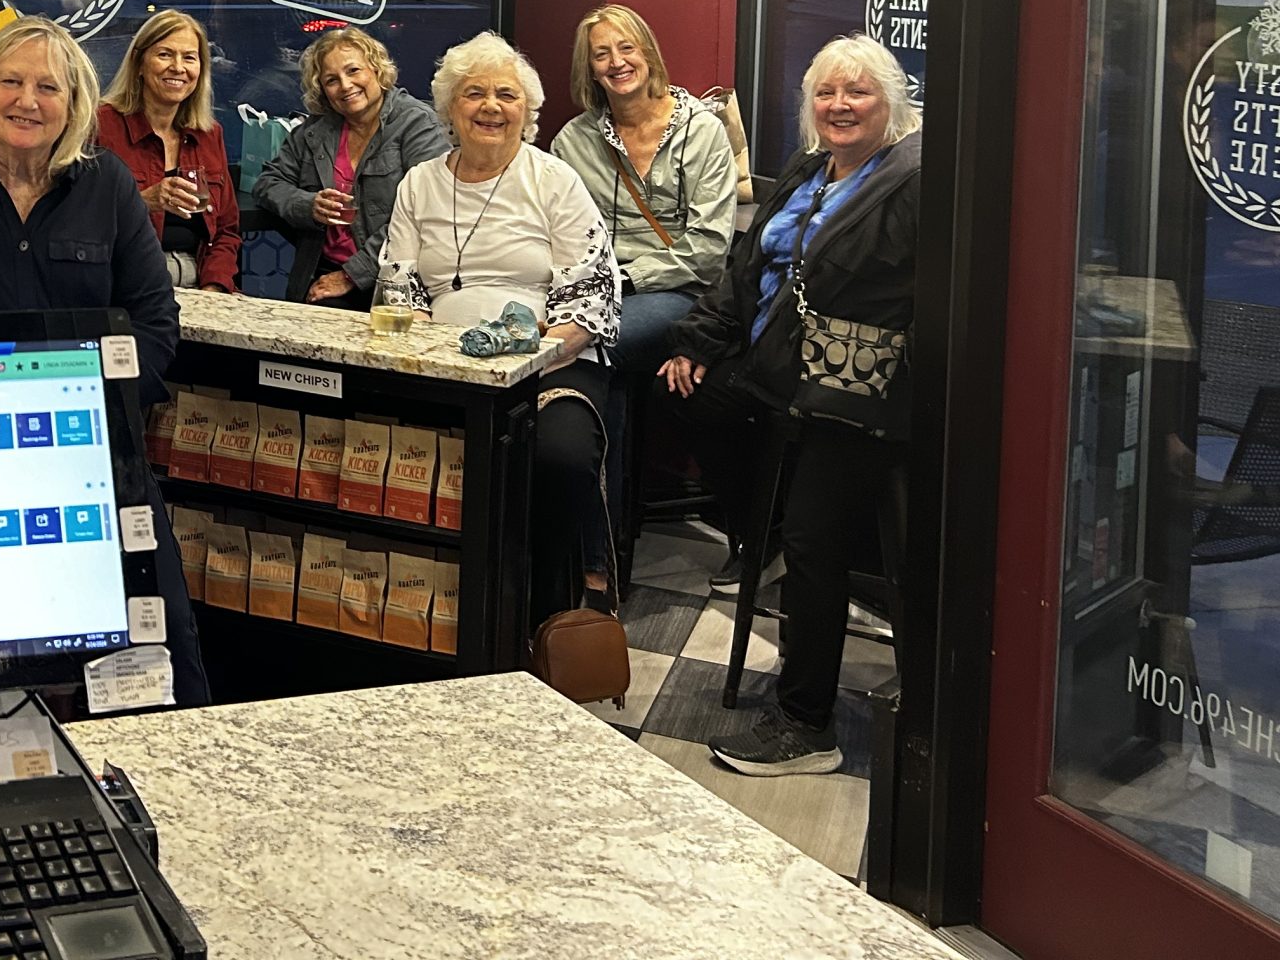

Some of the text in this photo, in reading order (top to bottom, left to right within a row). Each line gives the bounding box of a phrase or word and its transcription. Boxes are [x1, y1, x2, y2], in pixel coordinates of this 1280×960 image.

[265, 367, 292, 382] NEW
[294, 373, 330, 388] CHIPS
[220, 433, 251, 450] KICKER
[262, 441, 294, 457] KICKER
[308, 447, 342, 464] KICKER
[347, 455, 380, 473] KICKER
[394, 463, 427, 480] KICKER
